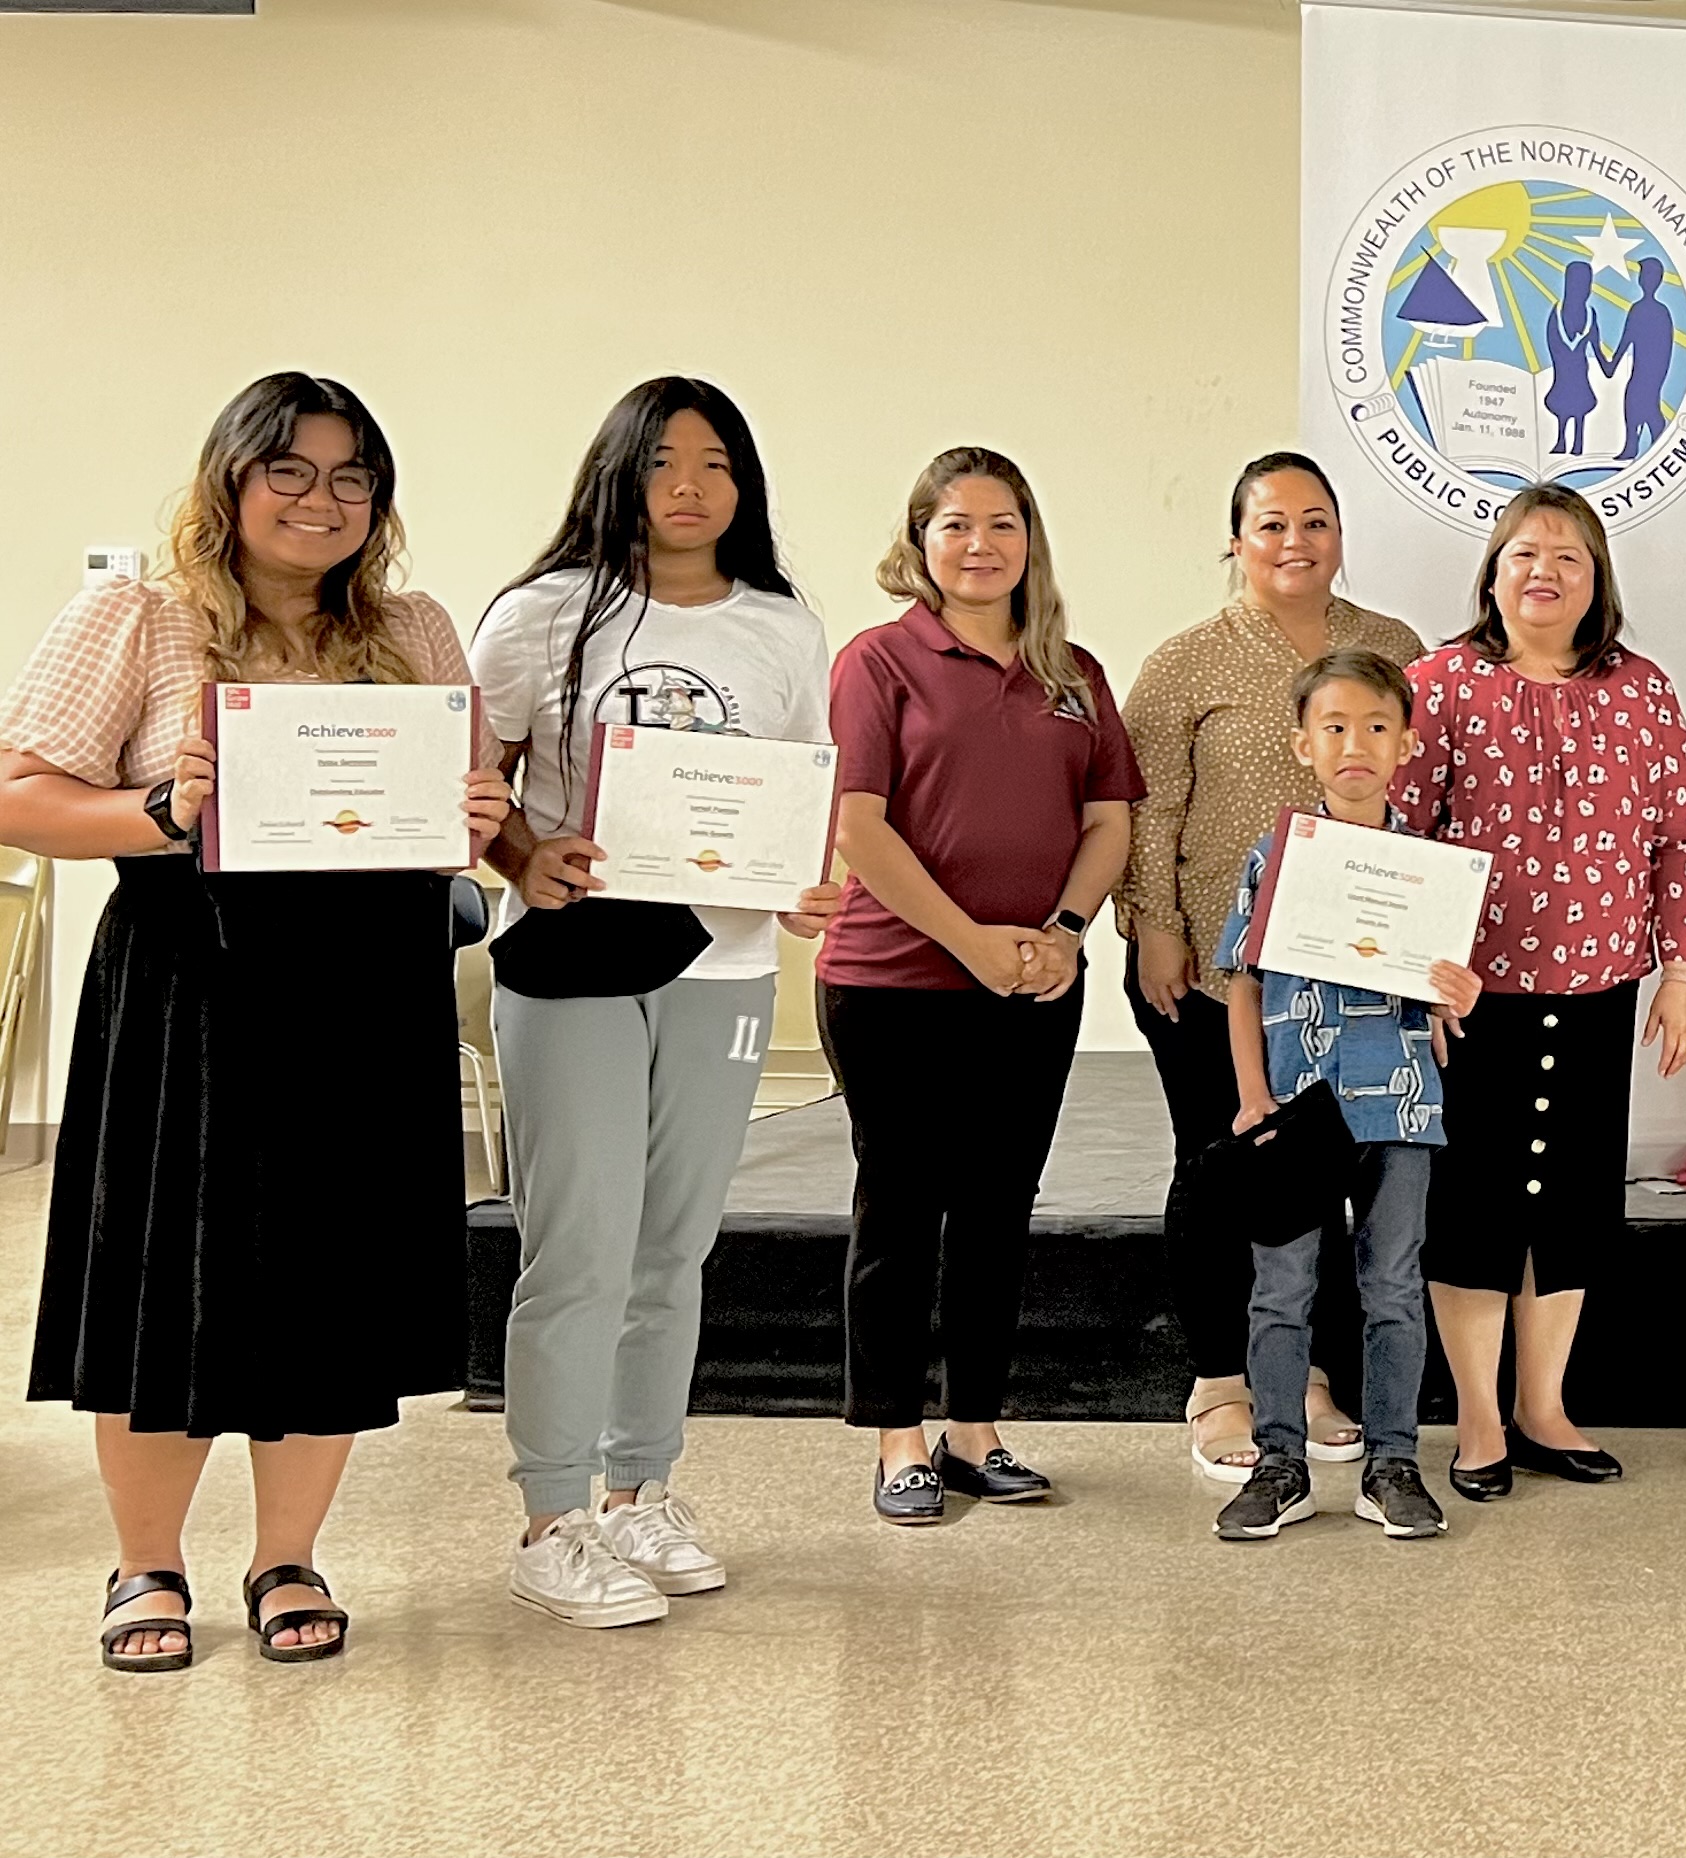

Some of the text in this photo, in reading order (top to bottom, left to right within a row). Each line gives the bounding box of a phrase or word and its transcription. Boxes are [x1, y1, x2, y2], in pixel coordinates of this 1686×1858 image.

[1341, 181, 1427, 384] COMMONWEALTH
[1425, 157, 1457, 189] OF
[1461, 141, 1513, 174] THE
[1520, 140, 1656, 201] NORTHERN
[1468, 379, 1517, 394] Founded
[1479, 395, 1505, 407] 1947
[1462, 408, 1518, 425] Autonomy
[1377, 428, 1467, 509] PUBLIC
[298, 723, 398, 738] Achieve3000
